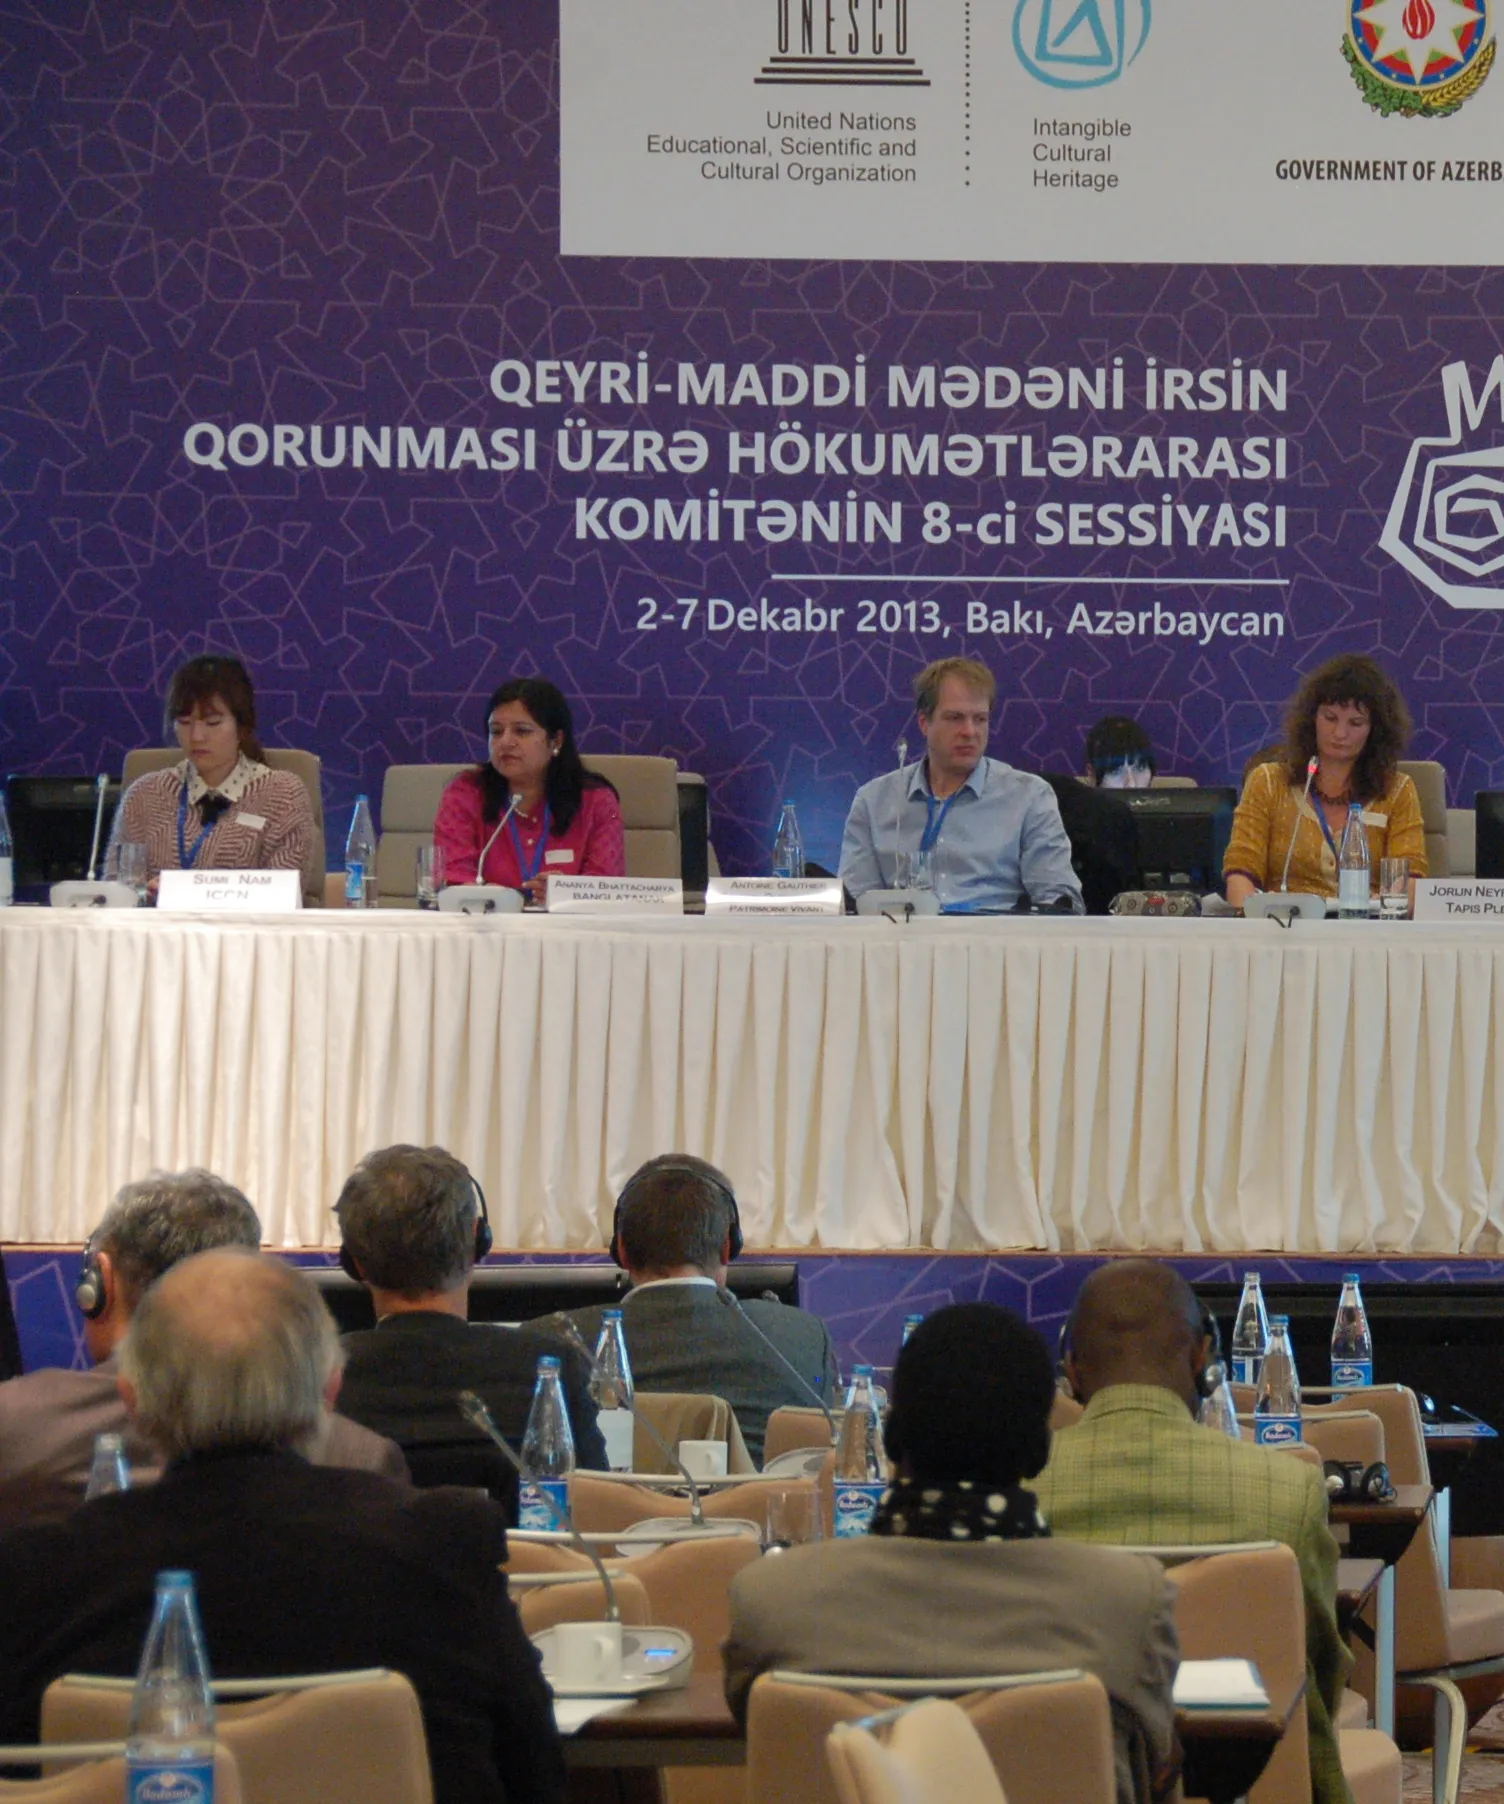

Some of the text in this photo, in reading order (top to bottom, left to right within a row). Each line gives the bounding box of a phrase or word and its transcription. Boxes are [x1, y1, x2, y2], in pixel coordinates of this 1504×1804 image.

[777, 0, 907, 55] UNESCO
[766, 110, 917, 132] United Nations
[1033, 117, 1132, 141] Intangible
[647, 134, 917, 158] Educational, Scientific and
[1032, 142, 1111, 163] Cultural
[700, 160, 917, 186] Cultural Organization
[1033, 168, 1119, 193] Heritage
[1275, 159, 1408, 181] GOVERNMENT
[1412, 160, 1436, 181] OF
[490, 350, 1287, 412] QEYRİ-MADDİ MƏDƏNİ İRSİN
[183, 417, 1287, 480] QORUNMASI ÜZRƏ HÖKUMƏTLƏRARASI
[575, 488, 1287, 548] KOMİTƏNİN 8-ci SESSİYASI
[636, 597, 1284, 646] 2-7 Dekabr 2013, Bakı, Azərbaycan
